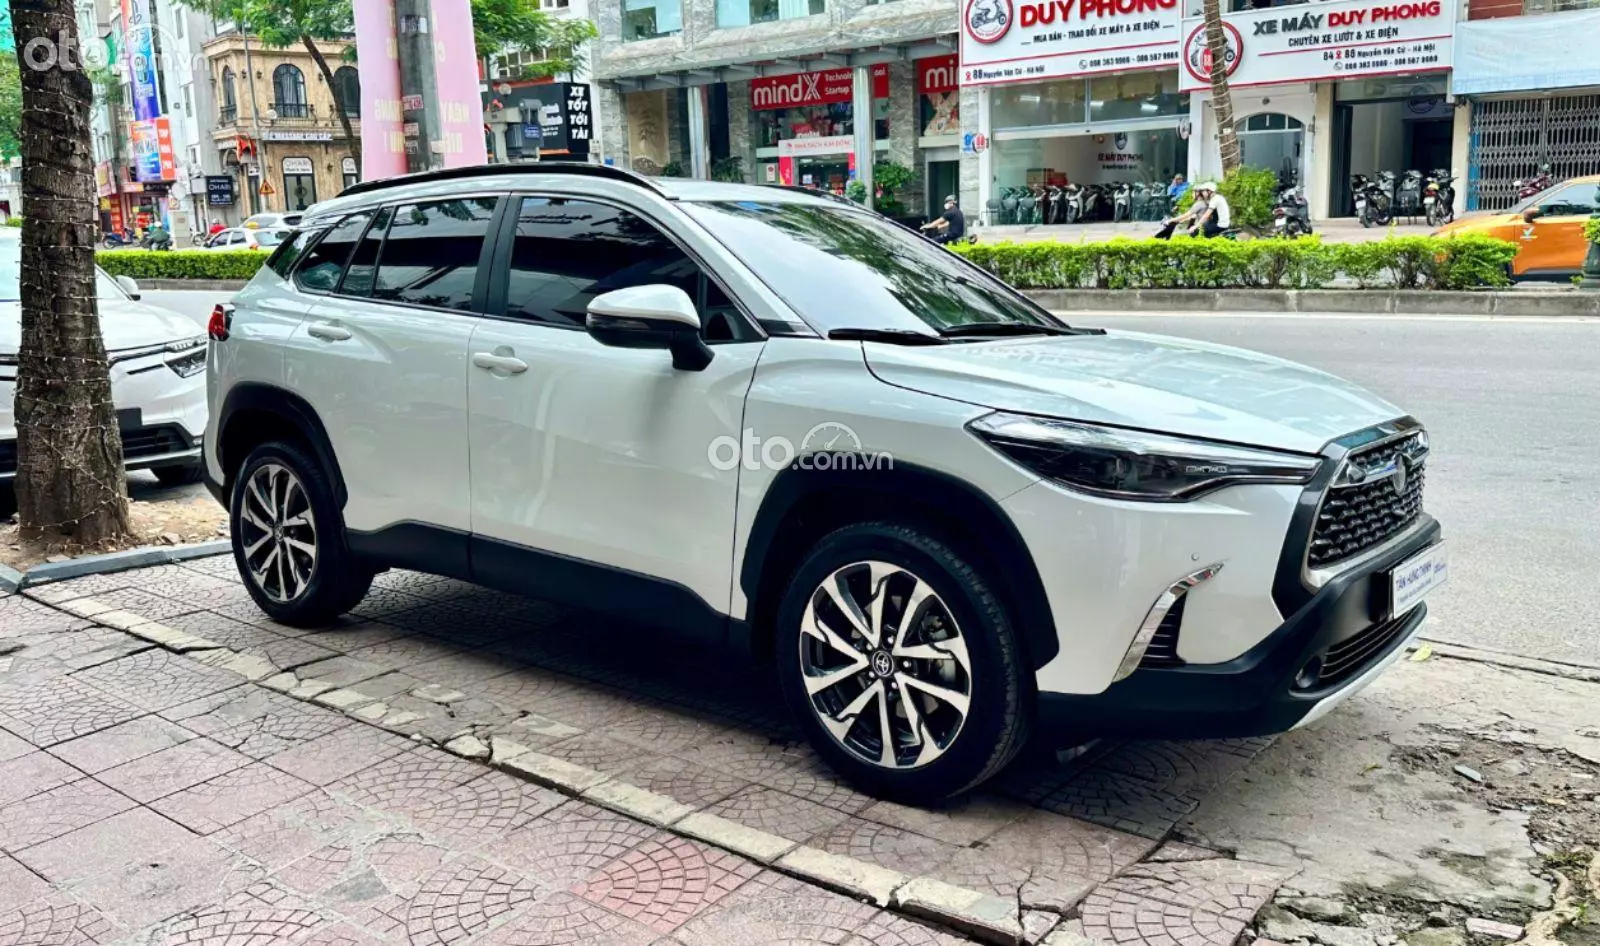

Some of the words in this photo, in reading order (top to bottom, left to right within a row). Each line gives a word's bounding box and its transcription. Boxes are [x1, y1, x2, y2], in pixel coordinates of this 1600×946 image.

[1020, 0, 1075, 28] DUY
[1253, 19, 1278, 36] XE
[1281, 12, 1324, 32] MÁY
[1328, 11, 1368, 28] DUY
[1371, 1, 1441, 23] PHONG
[1033, 33, 1047, 43] MUA
[1099, 26, 1108, 36] XE
[1132, 23, 1142, 32] XE
[1322, 34, 1333, 44] XE
[1356, 31, 1363, 40] &
[1365, 30, 1375, 39] XE
[570, 86, 584, 97] XE
[754, 73, 821, 106] mindX
[825, 85, 850, 97] Startup
[567, 97, 588, 111] TỐT
